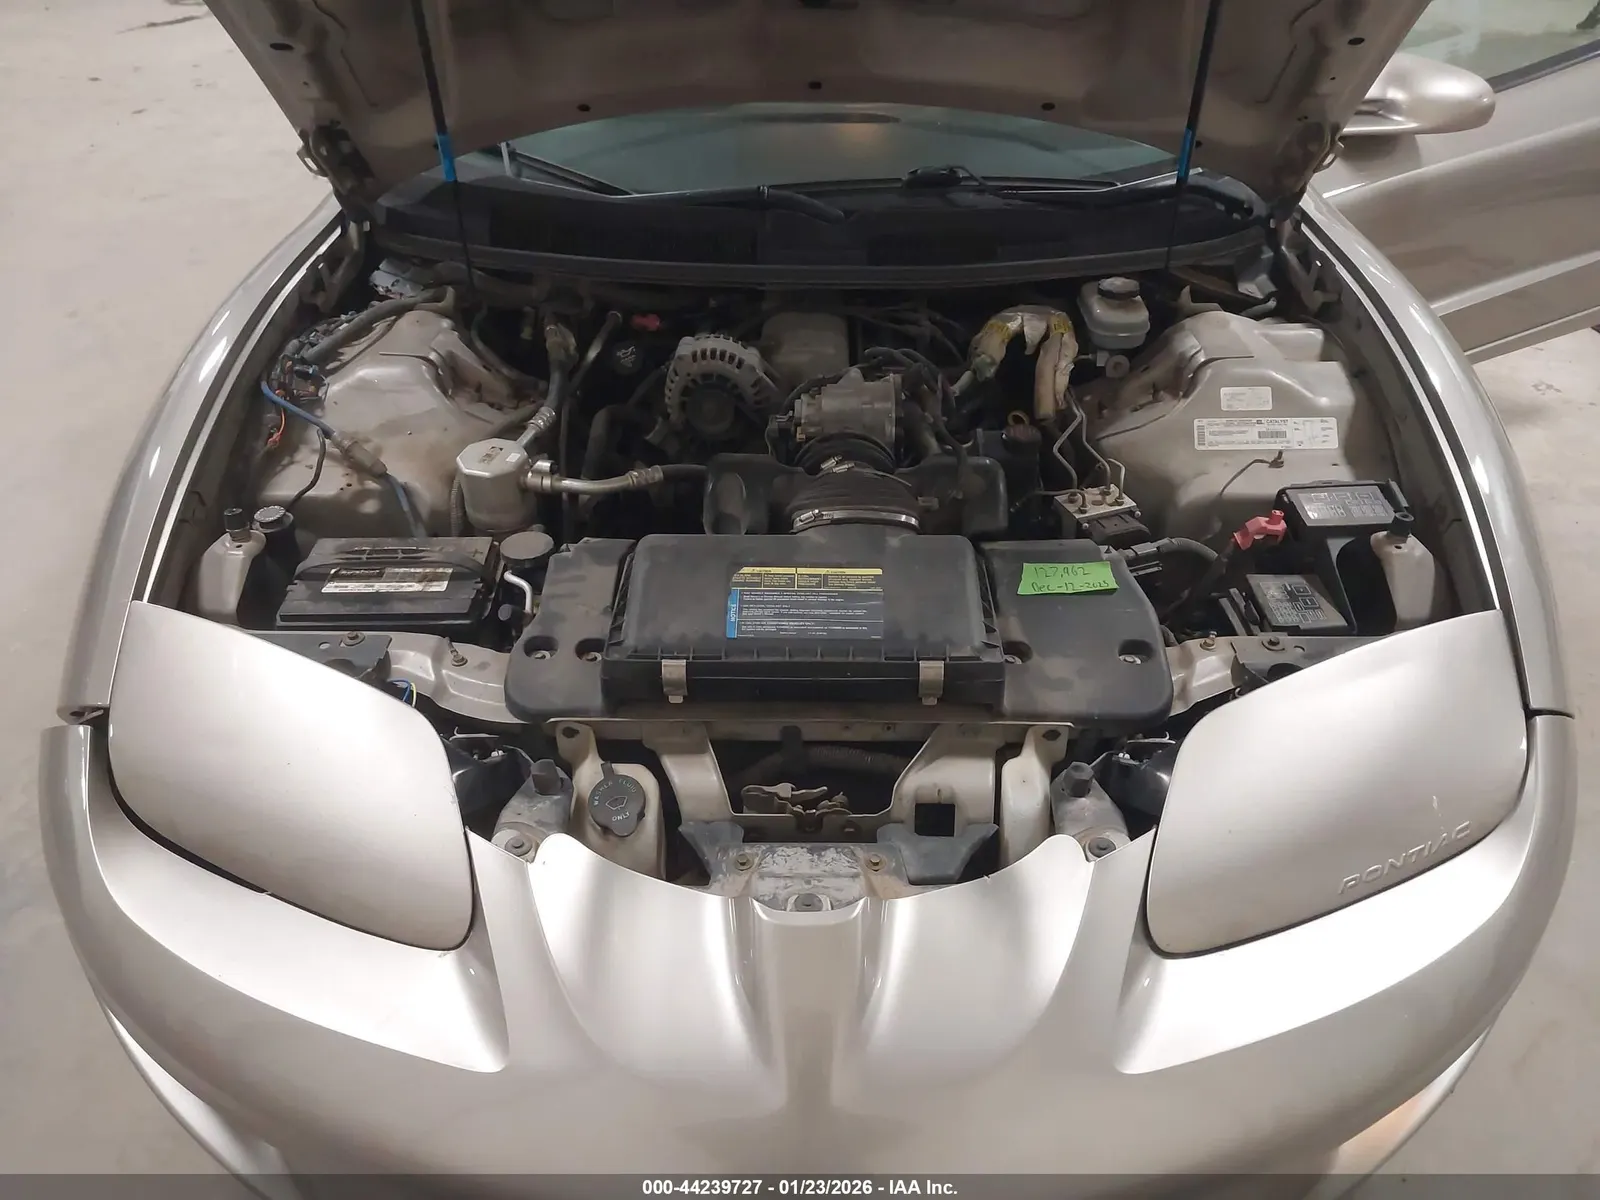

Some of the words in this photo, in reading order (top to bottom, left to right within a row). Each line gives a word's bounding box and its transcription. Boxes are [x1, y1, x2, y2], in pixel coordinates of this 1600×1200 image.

[1034, 566, 1091, 578] 127,962
[618, 778, 637, 793] FLUID
[611, 811, 630, 822] ONLY
[1338, 820, 1471, 895] PONTIAC
